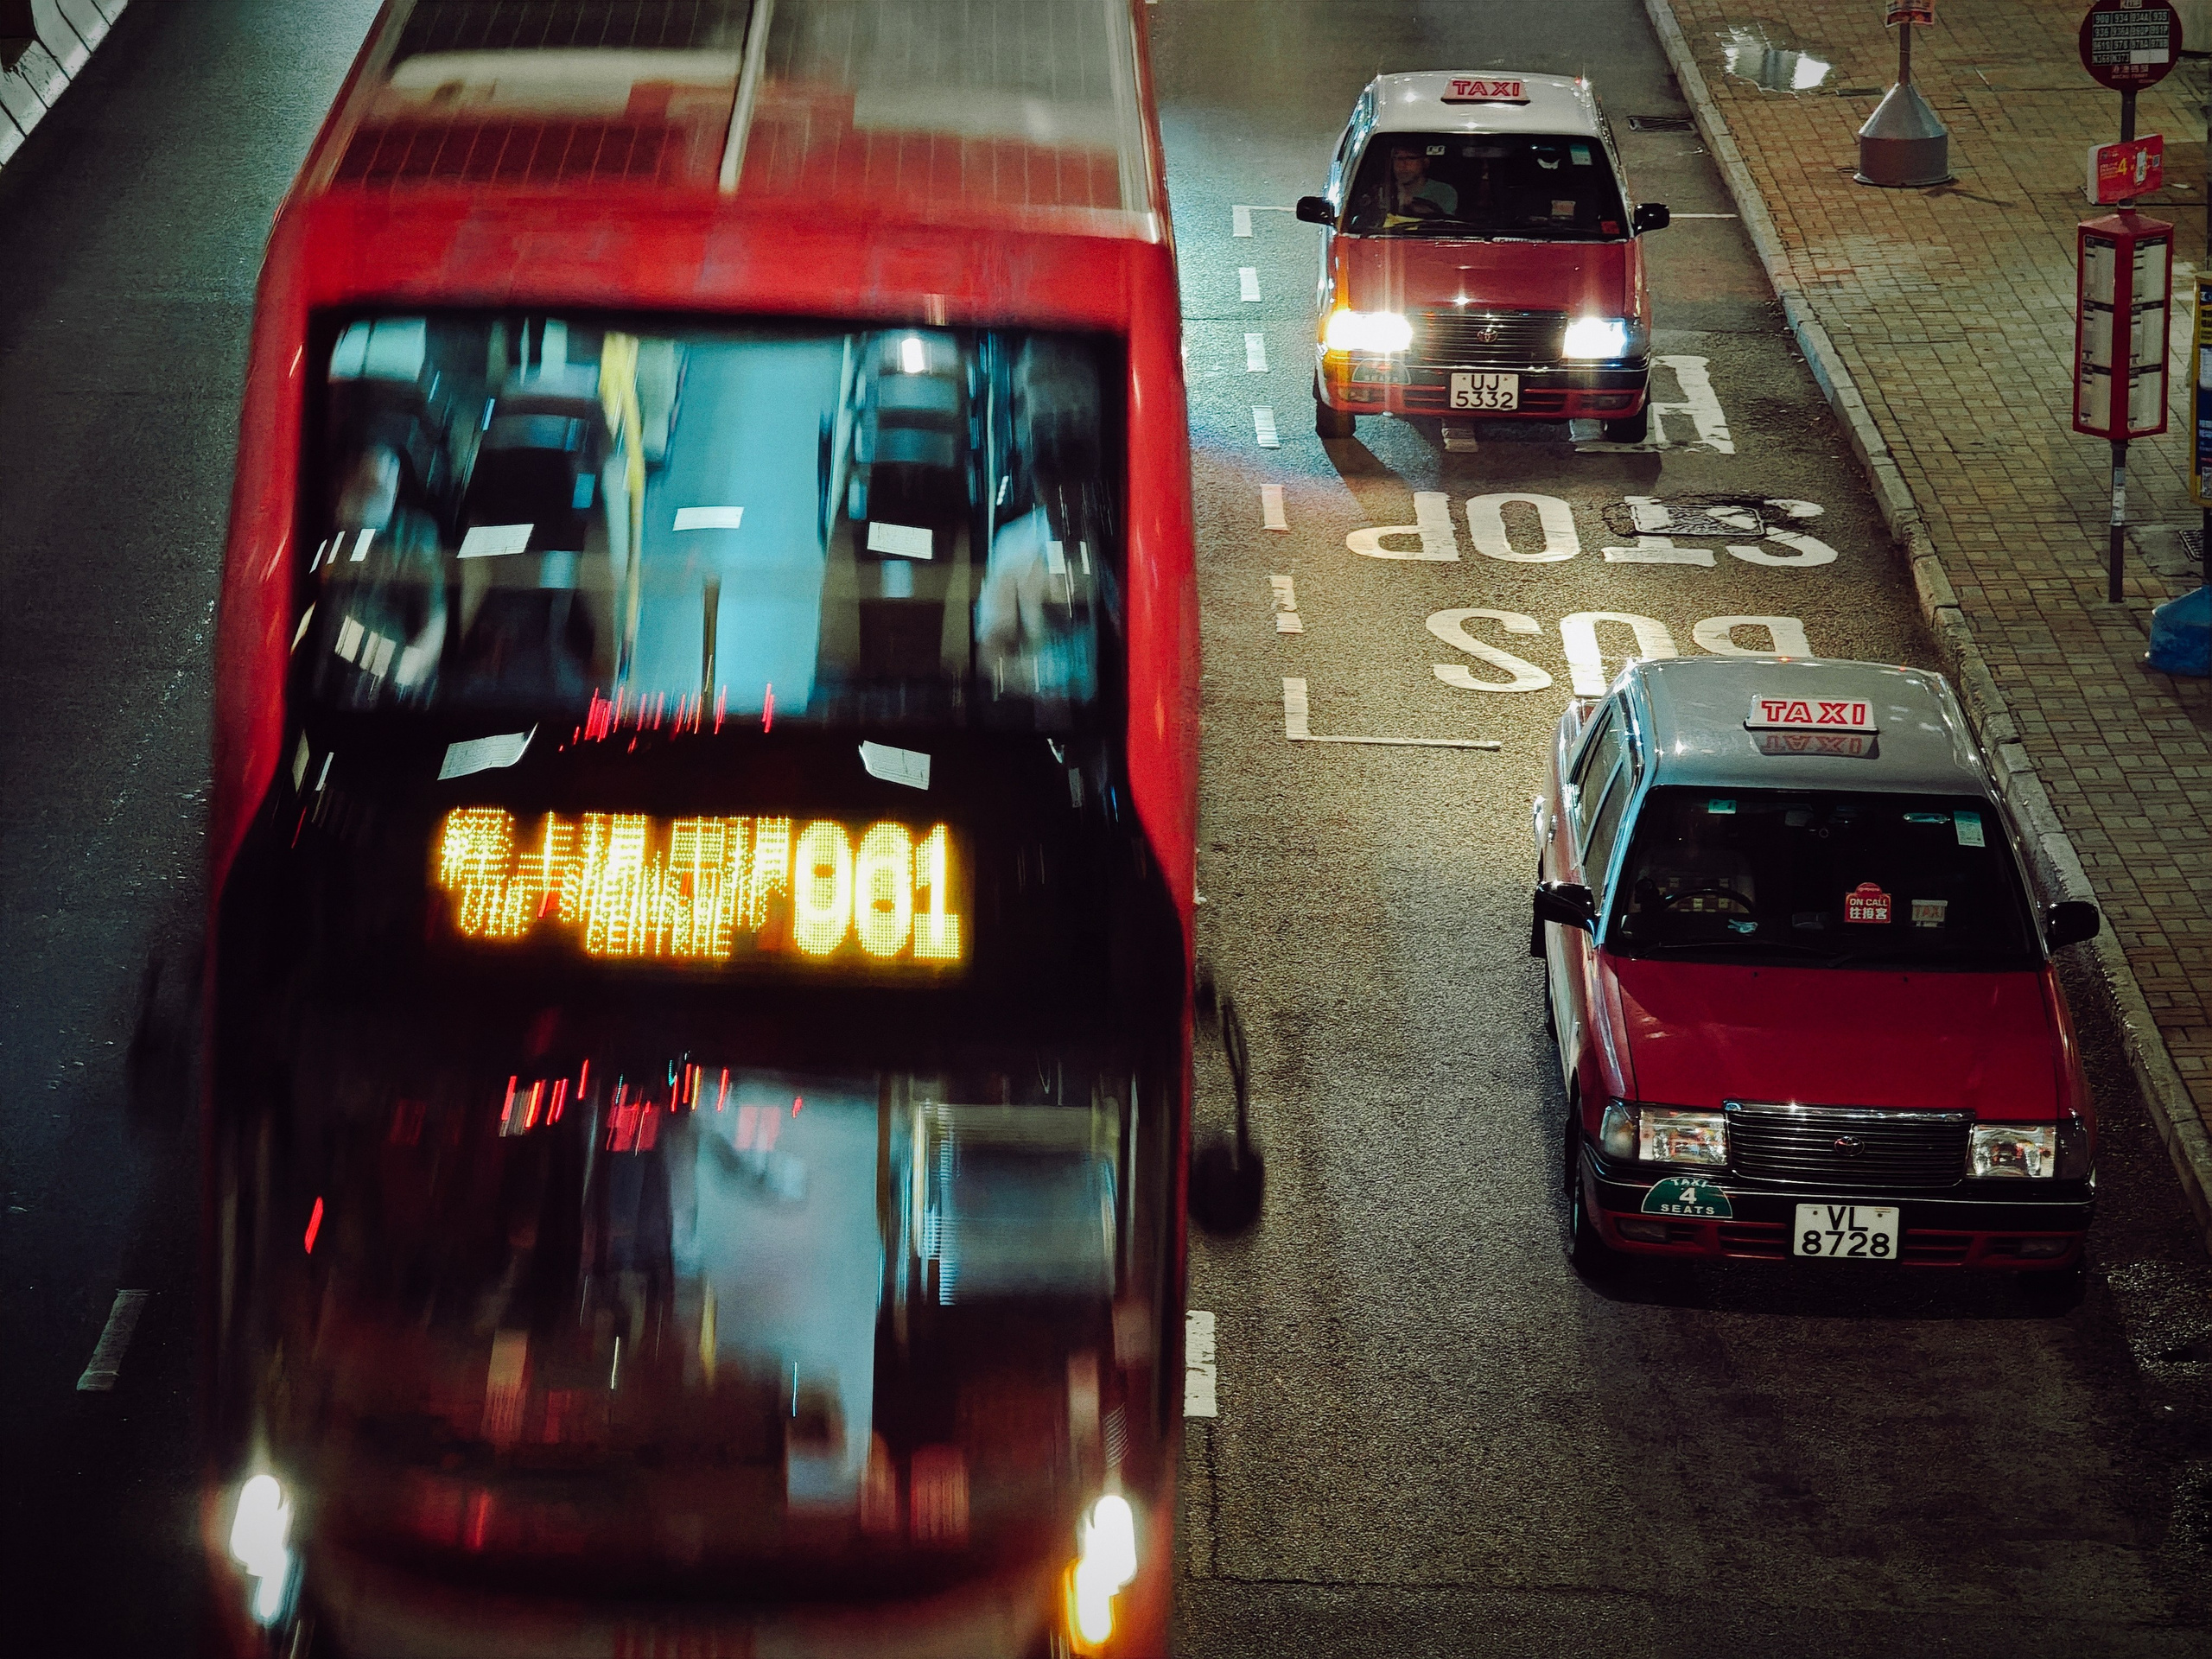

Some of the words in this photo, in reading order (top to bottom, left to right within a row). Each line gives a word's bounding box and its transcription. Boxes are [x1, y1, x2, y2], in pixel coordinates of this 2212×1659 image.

[1452, 80, 1520, 97] TAXI
[1471, 374, 1500, 391] UJ
[1456, 391, 1513, 408] 5332
[1345, 492, 1839, 567] STOP
[1761, 701, 1866, 725] TAXI
[1849, 898, 1863, 906] ON
[1866, 898, 1888, 906] CALL
[1671, 1178, 1708, 1188] TAXI
[1679, 1187, 1697, 1205] 4
[1661, 1204, 1715, 1215] SEATS
[1827, 1205, 1869, 1231] VL
[1802, 1230, 1891, 1258] 8728
